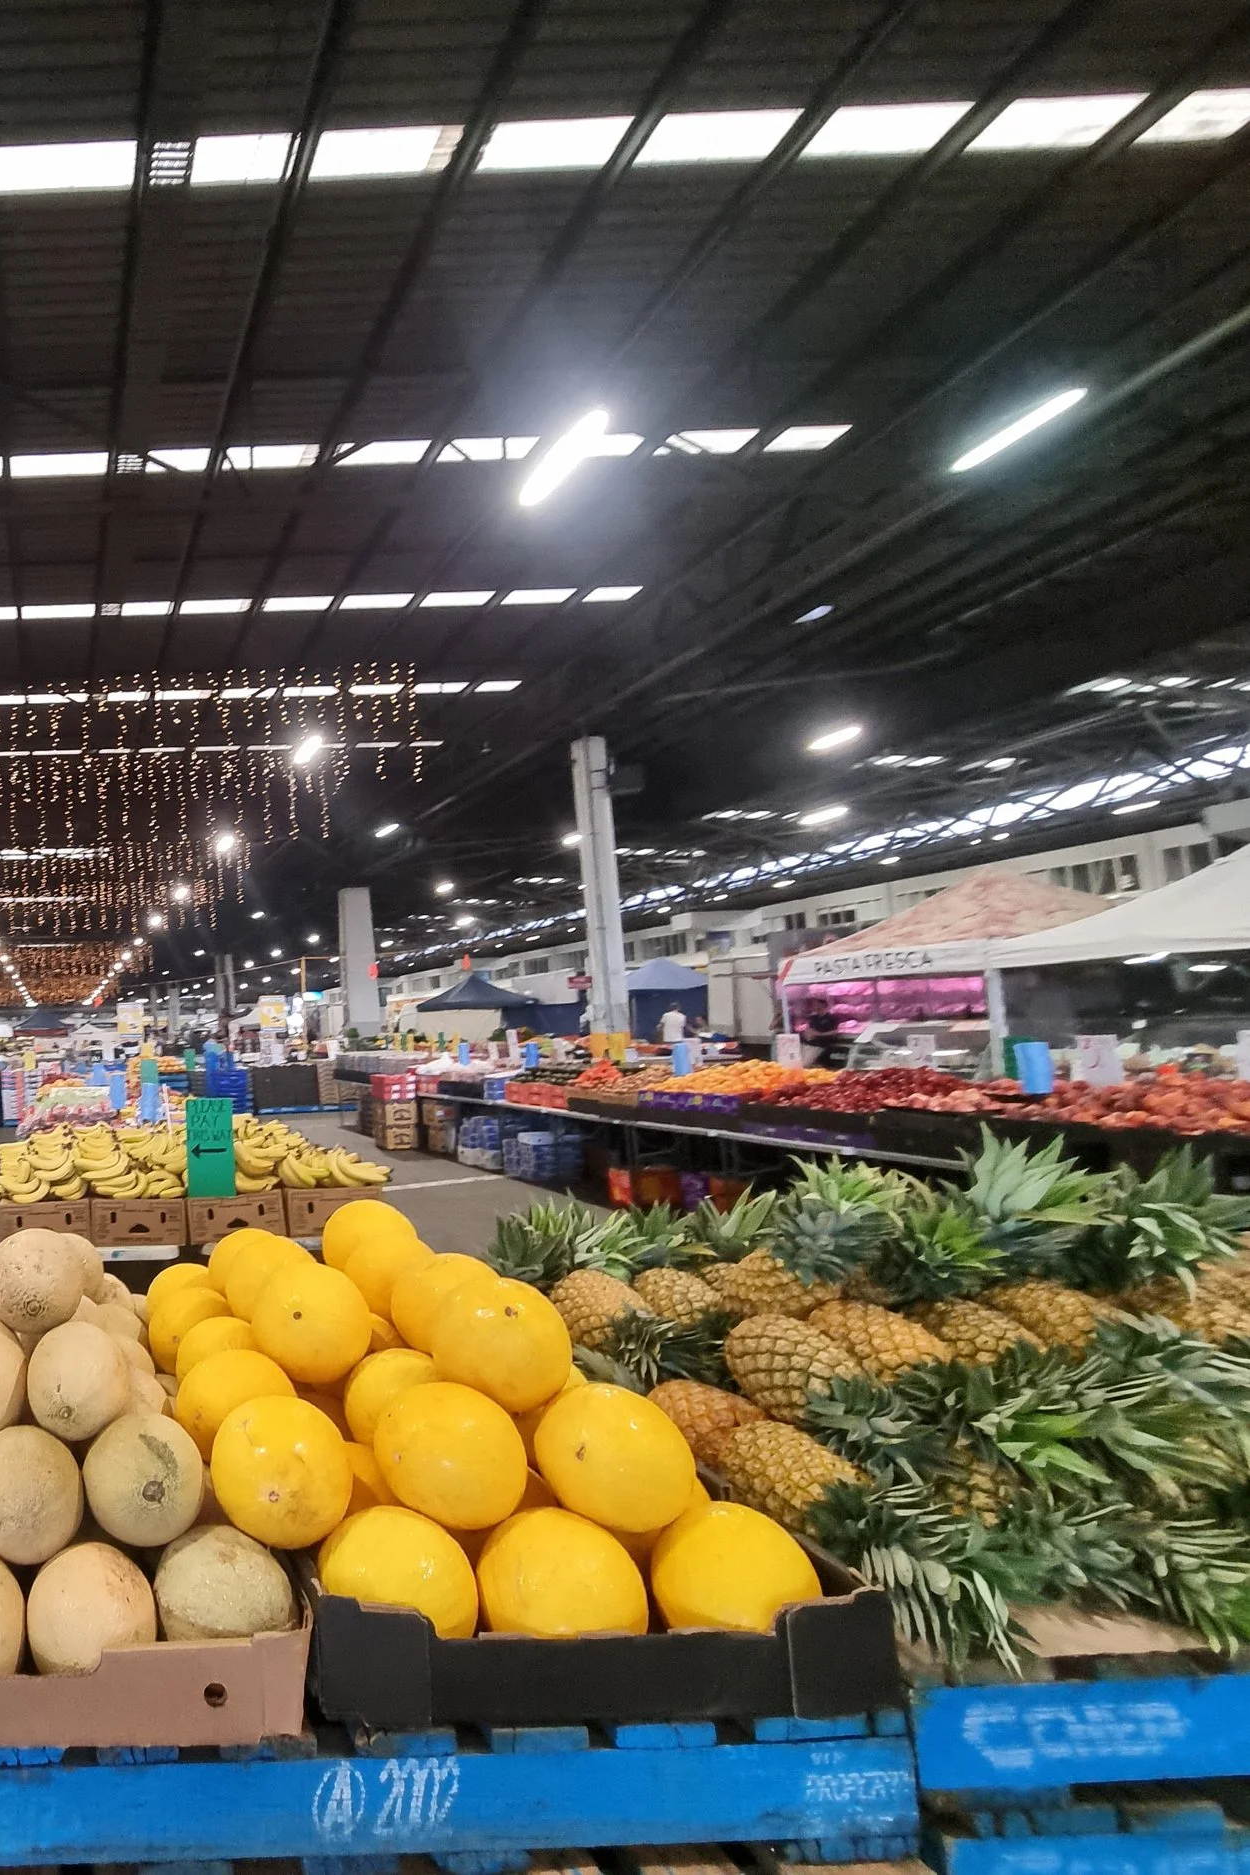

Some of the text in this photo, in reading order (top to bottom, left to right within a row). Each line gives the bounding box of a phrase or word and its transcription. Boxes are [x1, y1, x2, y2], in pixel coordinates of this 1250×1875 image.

[813, 950, 933, 976] PASTA FRESCA
[190, 1114, 220, 1129] PAY
